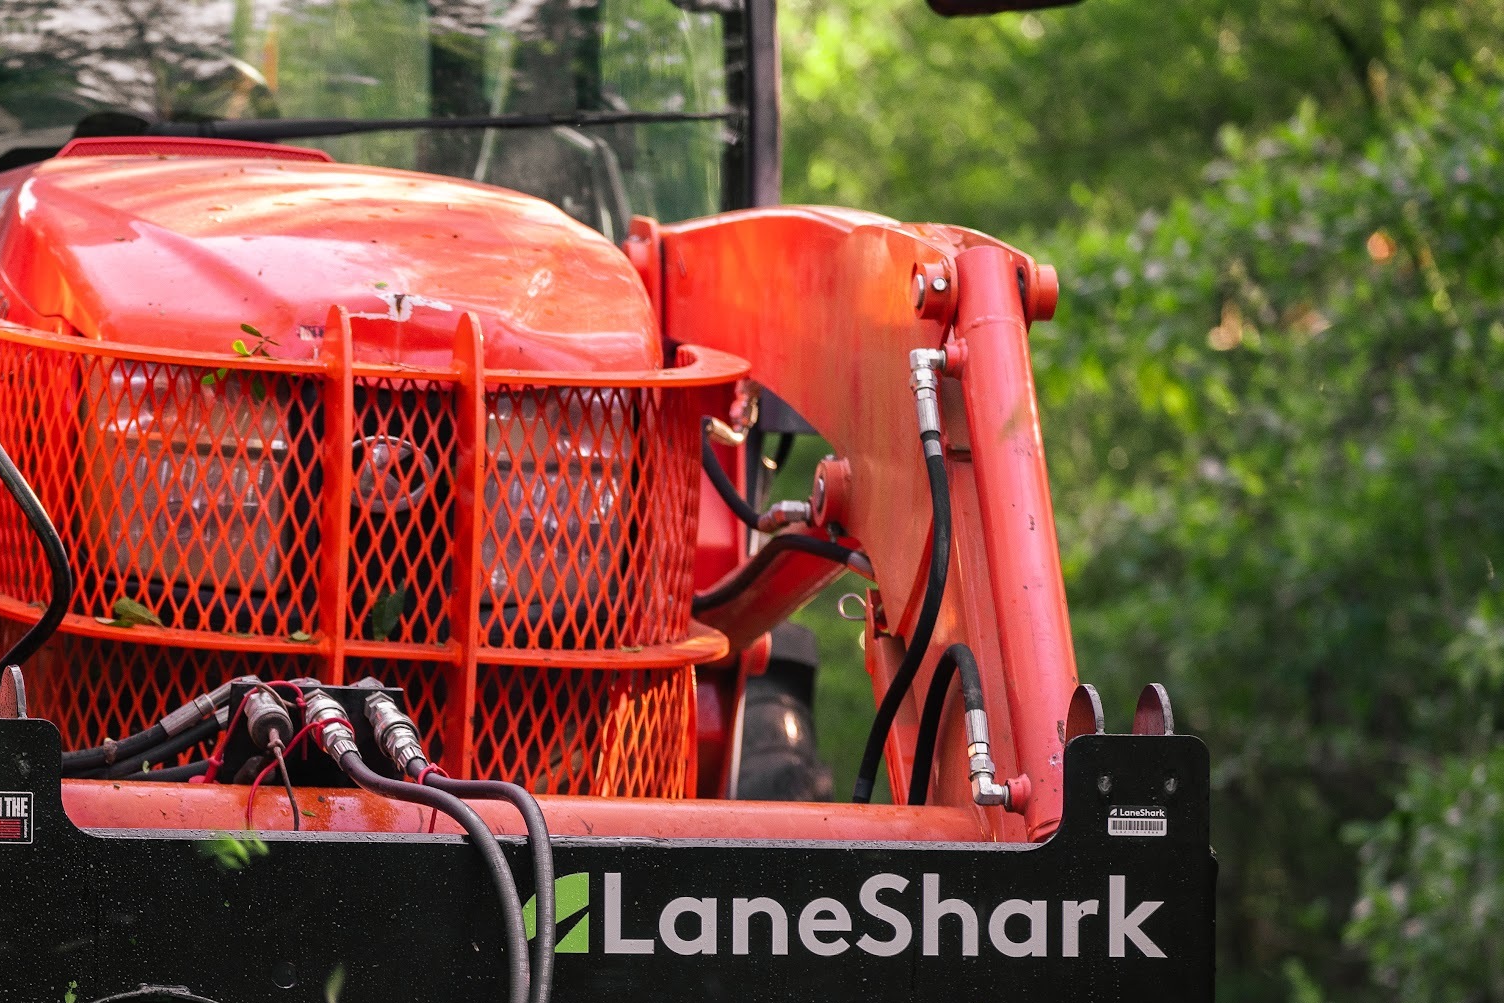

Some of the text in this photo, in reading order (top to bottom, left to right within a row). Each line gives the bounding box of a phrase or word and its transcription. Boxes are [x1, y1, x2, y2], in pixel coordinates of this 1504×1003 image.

[4, 797, 28, 817] THE
[1120, 808, 1165, 817] LaneShark
[604, 872, 1168, 958] LaneShark
